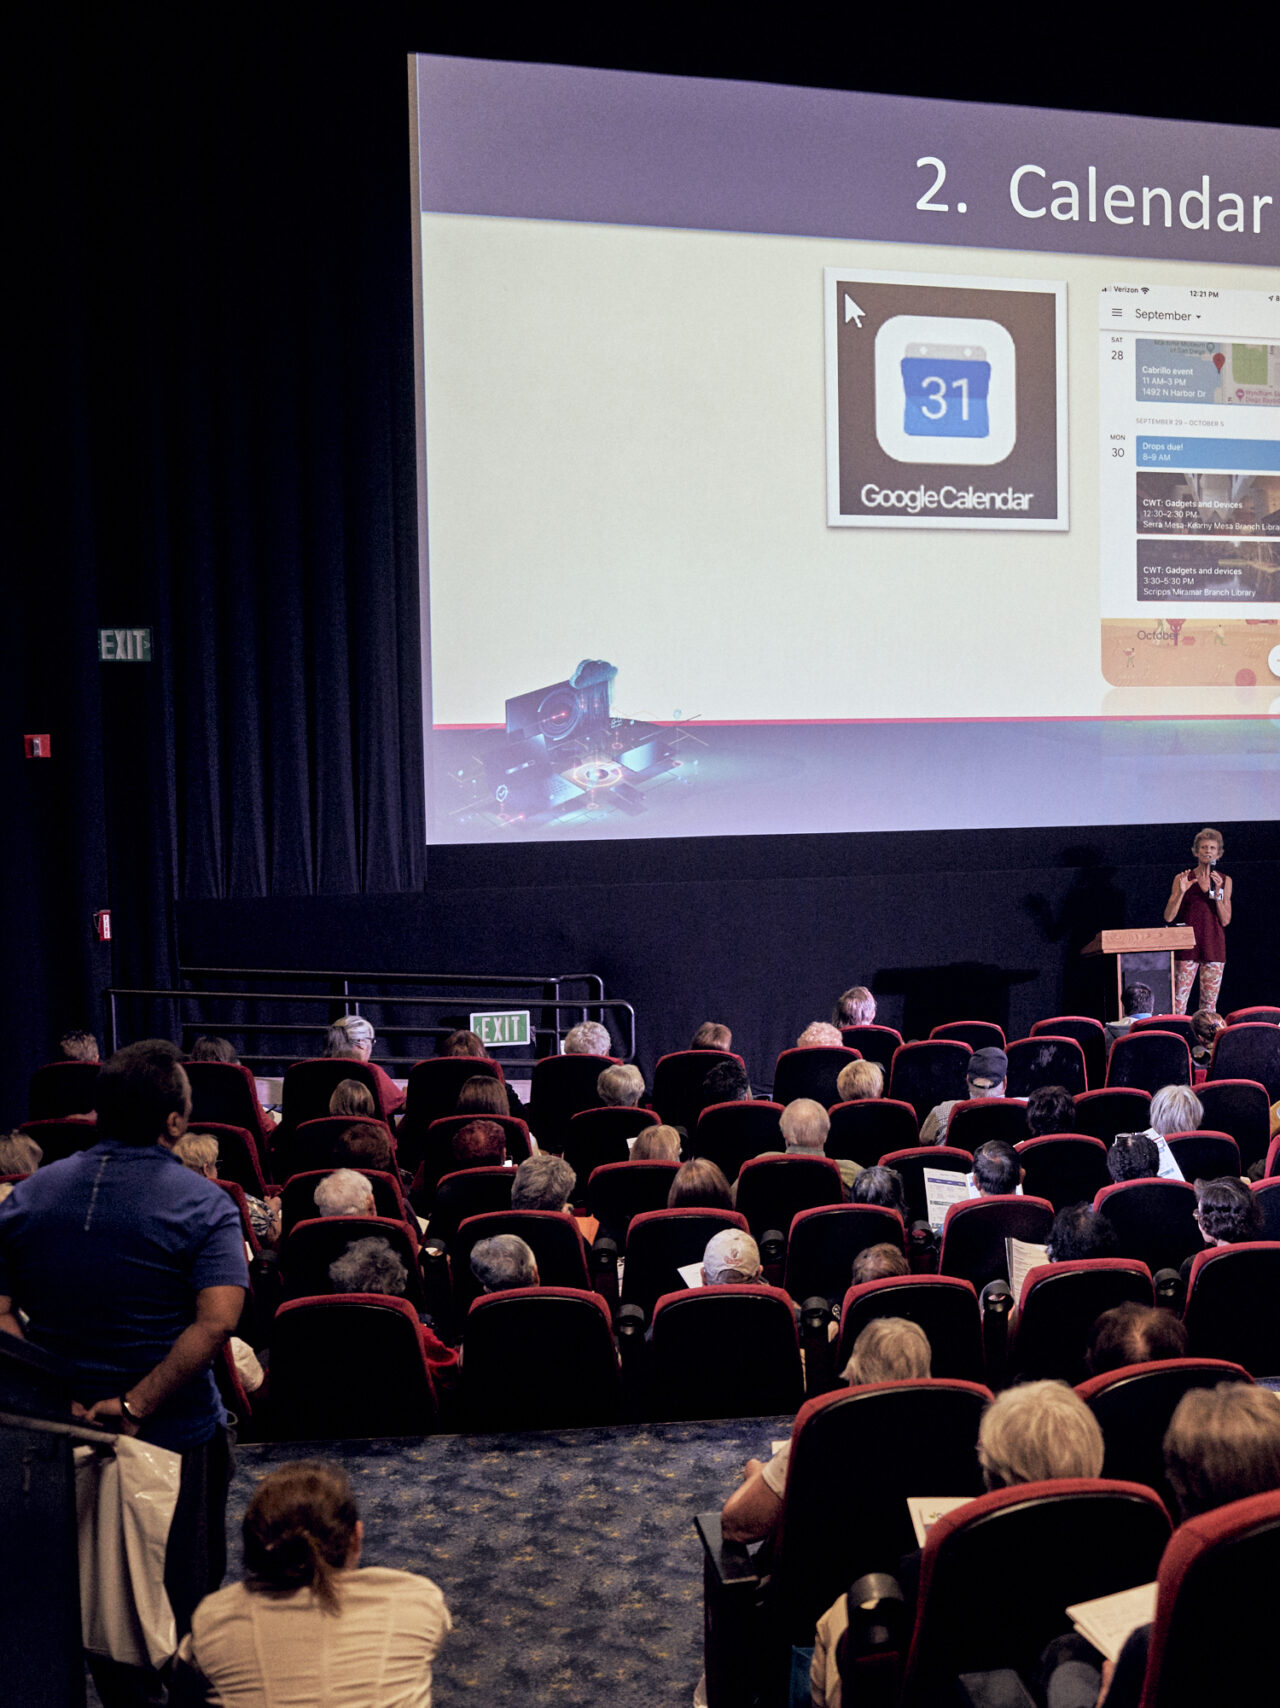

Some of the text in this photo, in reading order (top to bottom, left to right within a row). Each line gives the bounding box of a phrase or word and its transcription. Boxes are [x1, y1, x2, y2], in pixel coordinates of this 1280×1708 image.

[916, 156, 1273, 233] 2. Calendar
[1135, 308, 1191, 321] September
[1111, 350, 1124, 361] 28
[1142, 366, 1193, 376] Cabrillo event
[1142, 377, 1150, 385] 11
[1174, 378, 1187, 386] PM
[1143, 387, 1206, 398] 1492 N Harbor Dr
[921, 376, 968, 421] 31
[1135, 417, 1173, 425] SEPTEMBER
[1188, 419, 1218, 427] OCTOBER
[1142, 442, 1184, 451] Drops due!
[1111, 447, 1125, 458] 30
[861, 484, 1034, 513] Google Calendar
[1142, 498, 1243, 509] CWT: Gadgets and Devices
[1185, 511, 1198, 519] PM
[1143, 521, 1163, 529] Serra
[1213, 522, 1234, 530] Mesa
[1234, 522, 1260, 530] Branch
[1142, 566, 1243, 576] CWT: Gadgets and devices
[1143, 588, 1257, 598] Scripps Miramar Branch Library
[1137, 629, 1180, 641] October
[100, 629, 145, 660] EXIT
[481, 1015, 520, 1042] EXIT
